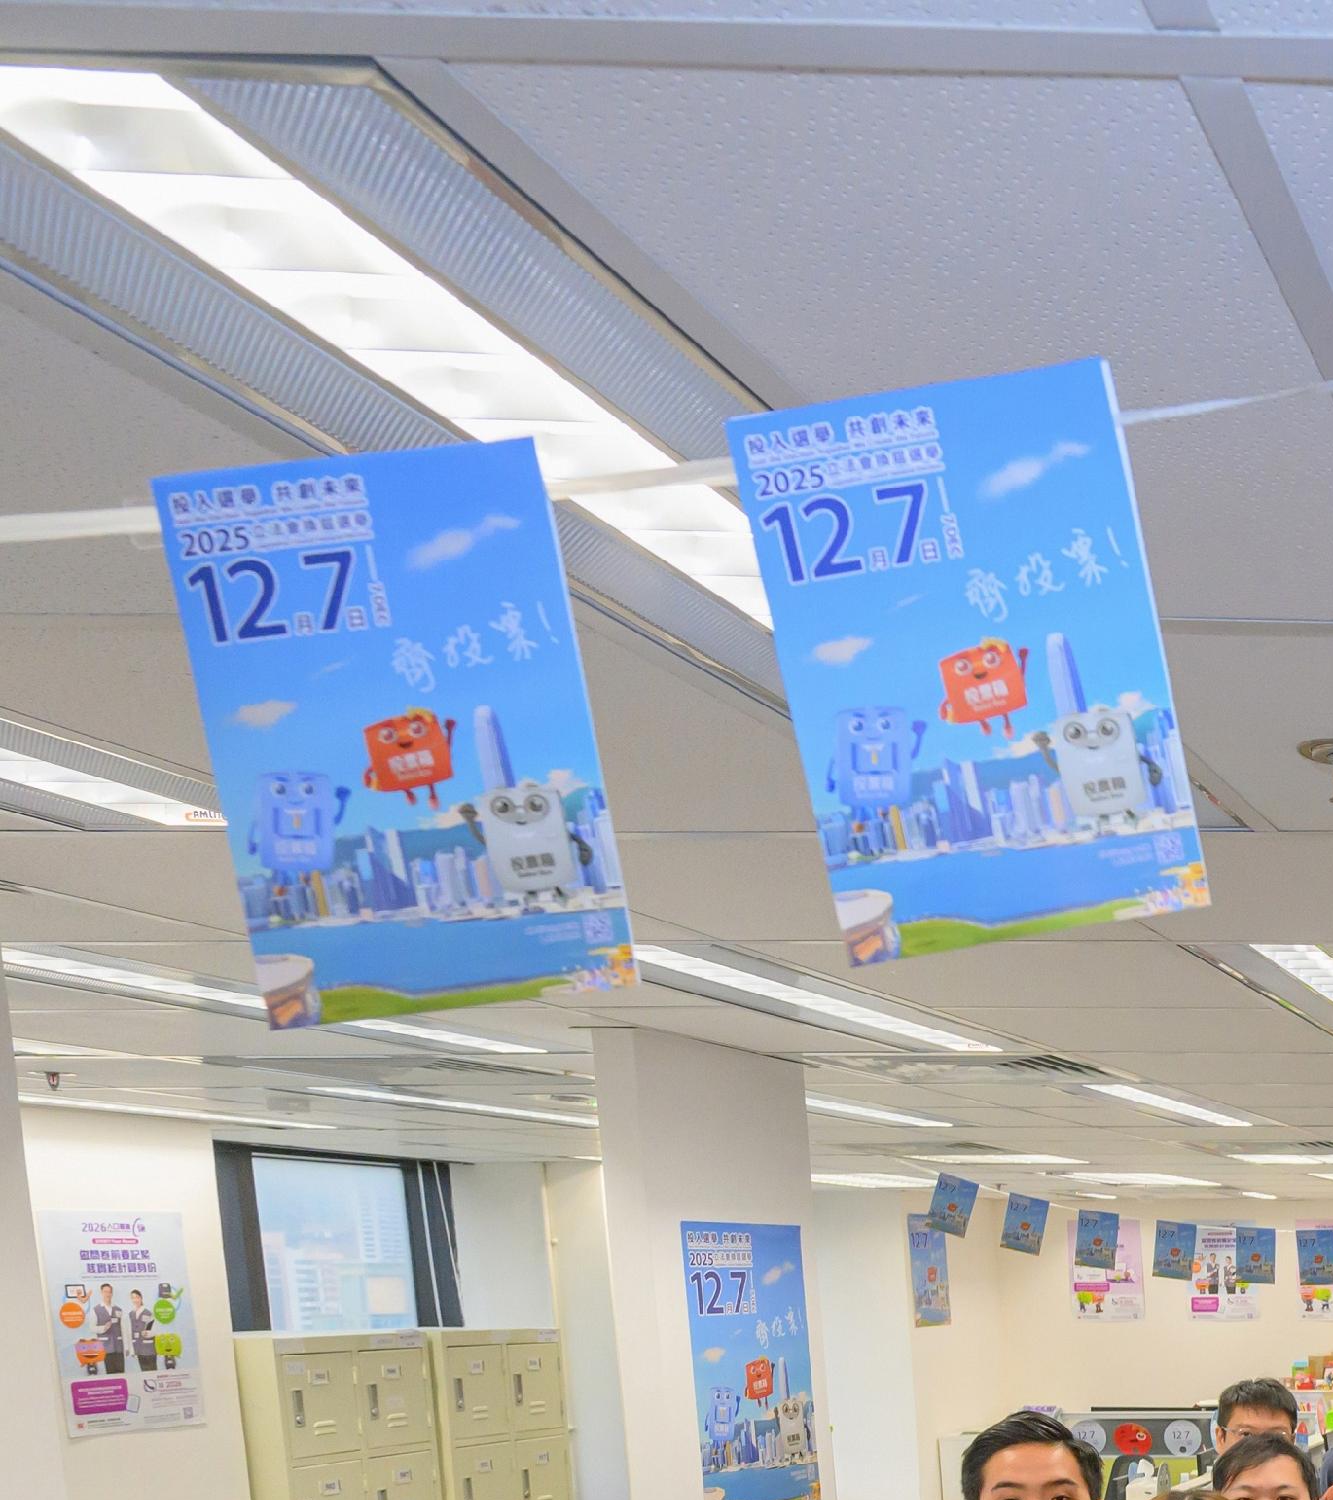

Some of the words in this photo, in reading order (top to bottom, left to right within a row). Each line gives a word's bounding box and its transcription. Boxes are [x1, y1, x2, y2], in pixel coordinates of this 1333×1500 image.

[748, 426, 831, 454] 投入選舉
[849, 410, 934, 437] 共創未來
